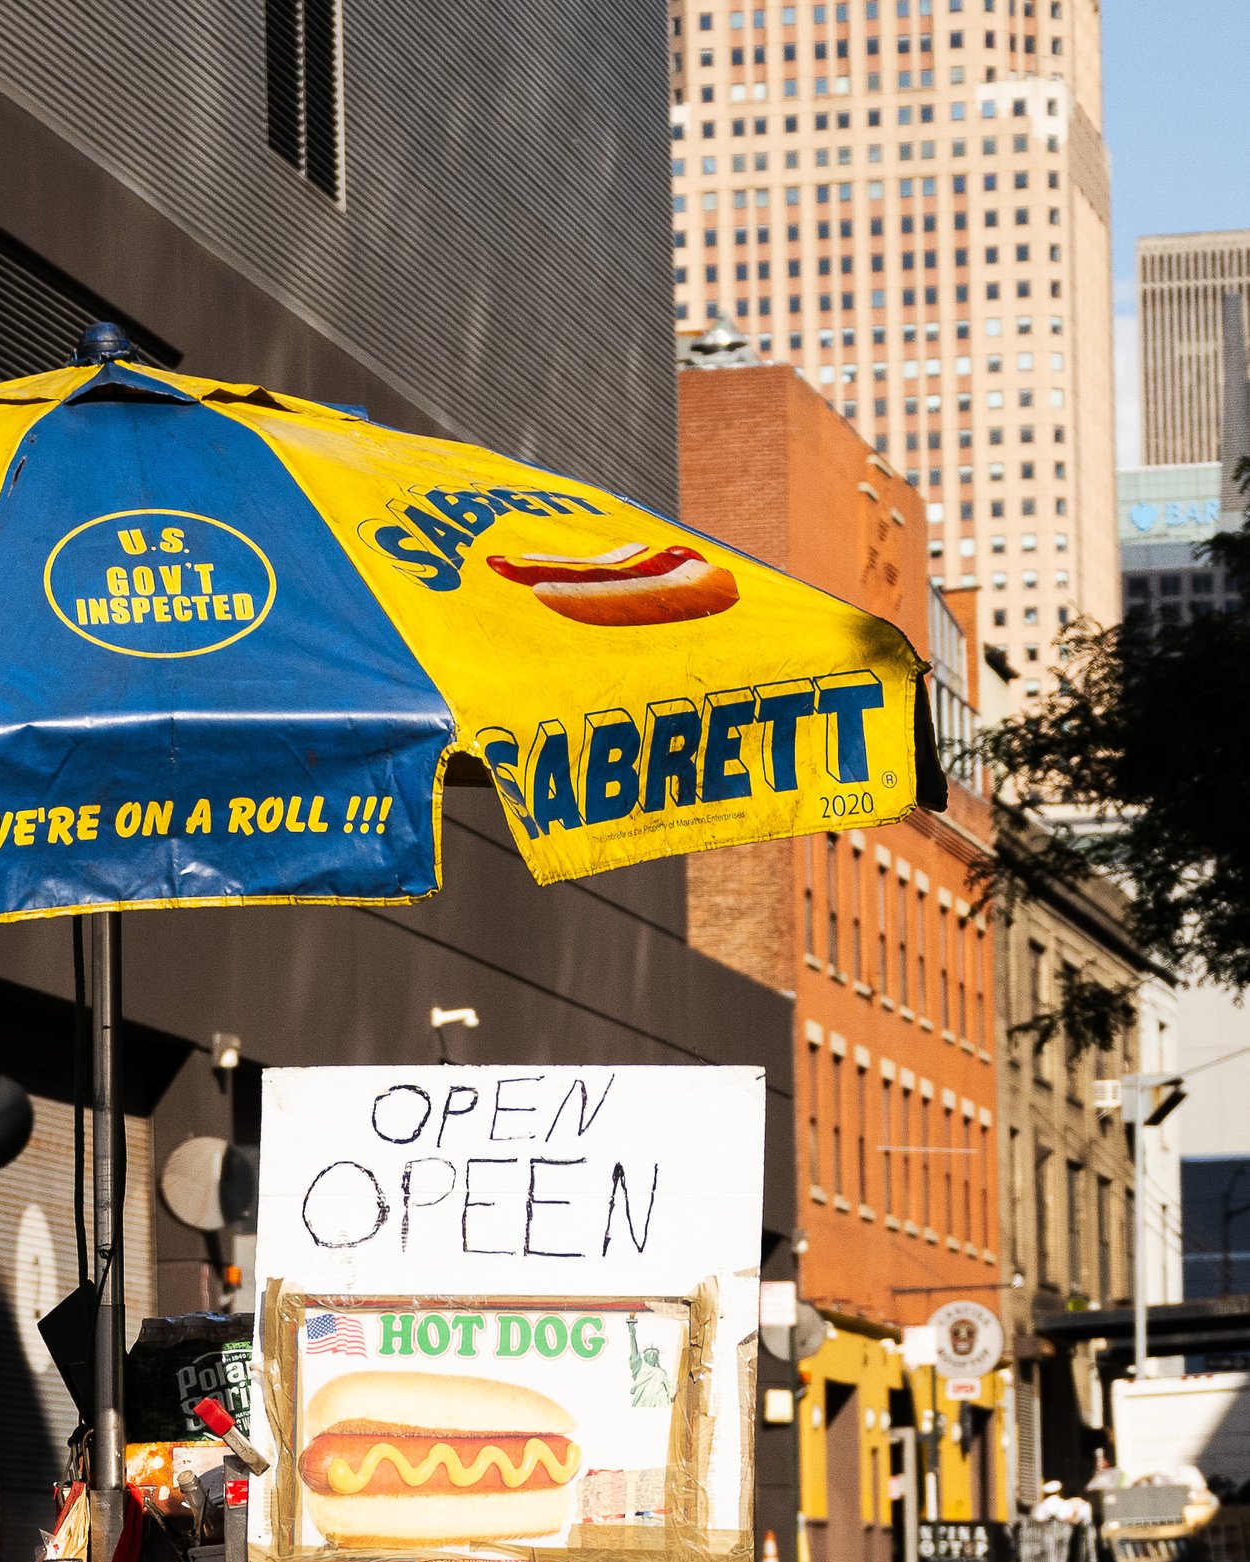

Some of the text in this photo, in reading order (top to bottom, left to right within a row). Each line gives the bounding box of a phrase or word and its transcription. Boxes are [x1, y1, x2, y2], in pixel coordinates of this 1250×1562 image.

[117, 527, 190, 556] U.S.
[357, 482, 609, 592] SABRETT
[106, 562, 214, 597] GOV'T
[76, 594, 255, 626] INSPECTED
[477, 669, 885, 839] SABRETT
[115, 801, 175, 837] ON
[185, 803, 213, 834] A
[228, 795, 330, 835] ROLL
[343, 795, 394, 834] !!!
[820, 791, 874, 819] 2020
[371, 1073, 615, 1147] OPEN
[302, 1157, 659, 1258] OPEEN
[379, 1312, 607, 1359] HOT DOG
